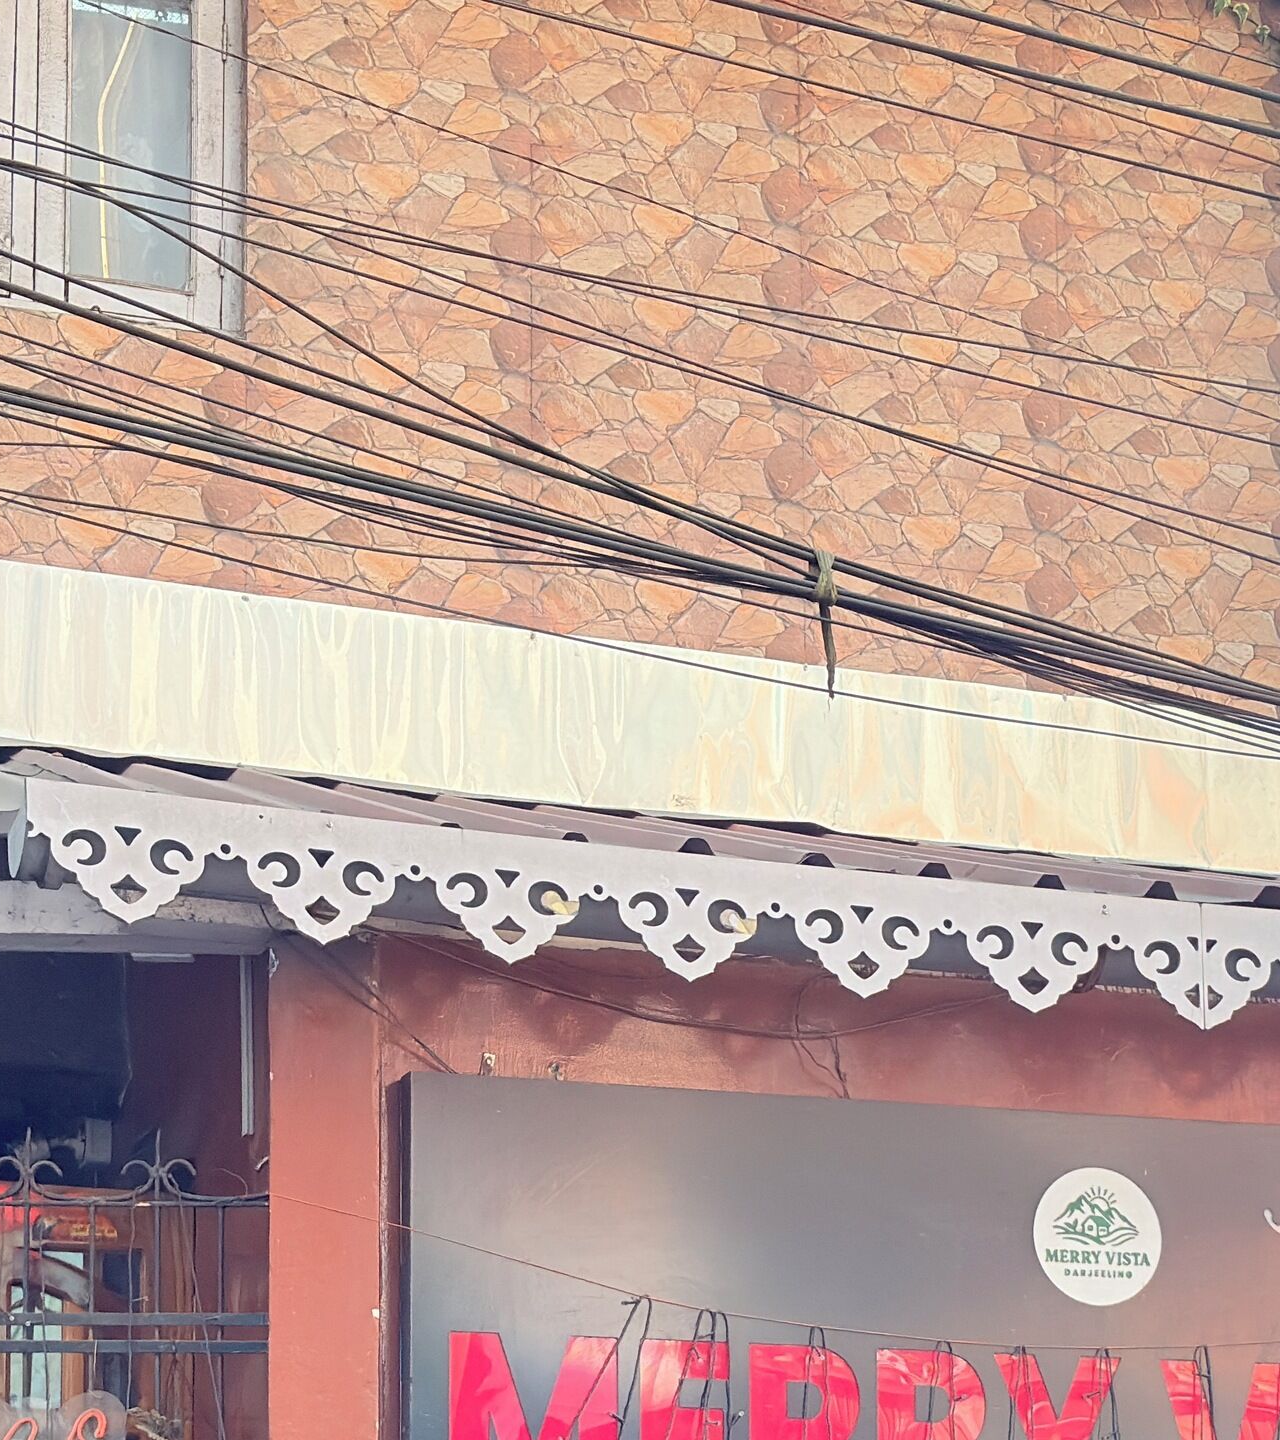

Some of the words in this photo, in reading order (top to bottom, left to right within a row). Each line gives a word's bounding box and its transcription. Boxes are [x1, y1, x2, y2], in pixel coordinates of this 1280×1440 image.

[1045, 1248, 1102, 1265] MERRY
[1106, 1251, 1152, 1267] VISTA
[1064, 1268, 1134, 1280] DARJEELING
